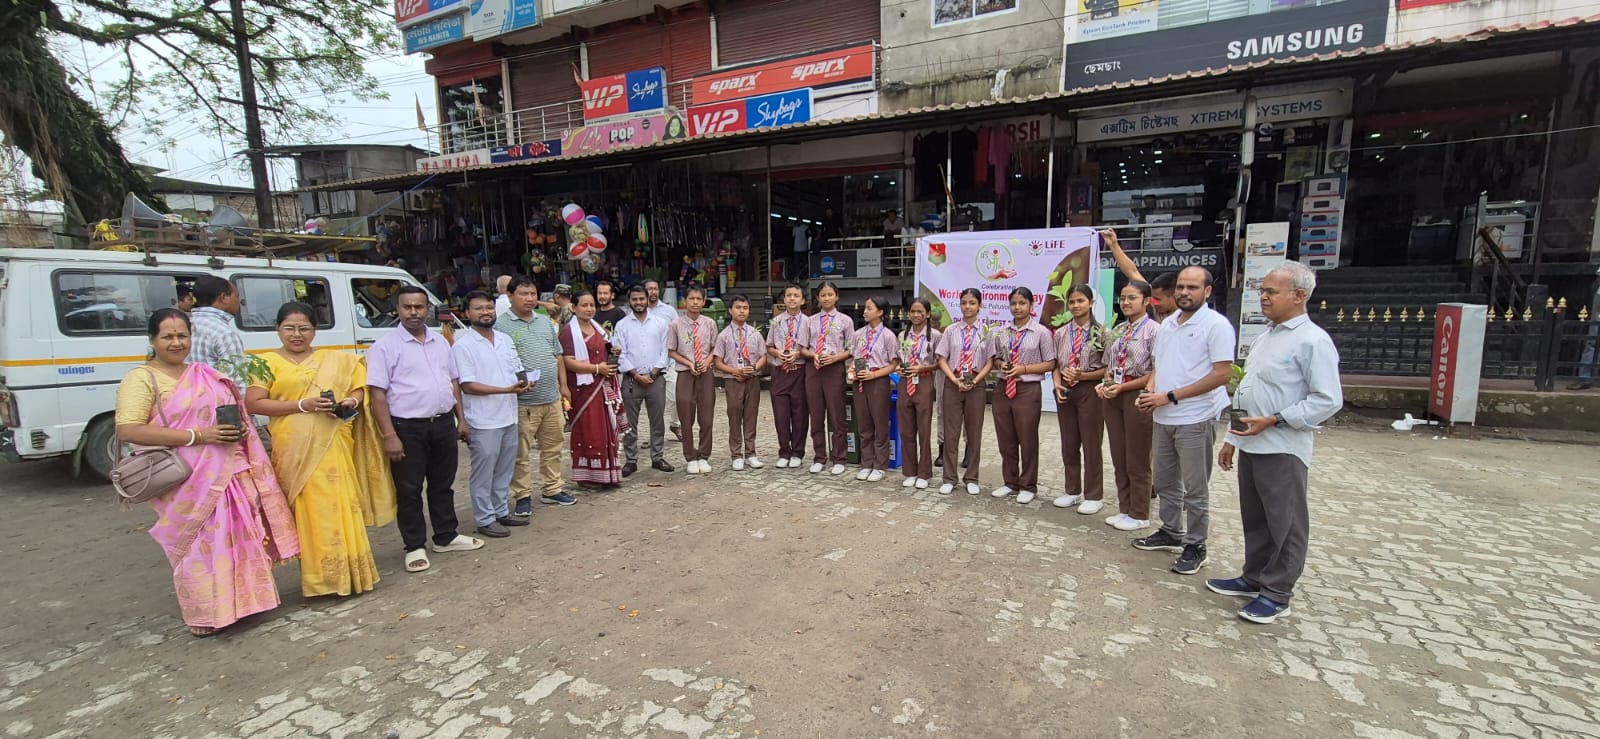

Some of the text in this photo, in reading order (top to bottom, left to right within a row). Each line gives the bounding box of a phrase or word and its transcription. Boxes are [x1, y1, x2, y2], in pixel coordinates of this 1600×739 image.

[1227, 23, 1364, 59] SAMSUNG
[708, 55, 851, 95] sparx sparx
[584, 84, 624, 110] VIP
[629, 80, 658, 100] Skybags
[692, 108, 739, 134] VIP
[753, 97, 802, 127] Skybags
[610, 127, 634, 142] POP
[1132, 254, 1217, 267] APPLIANCES
[981, 283, 1016, 291] Celebrating
[1435, 315, 1453, 406] Canon
